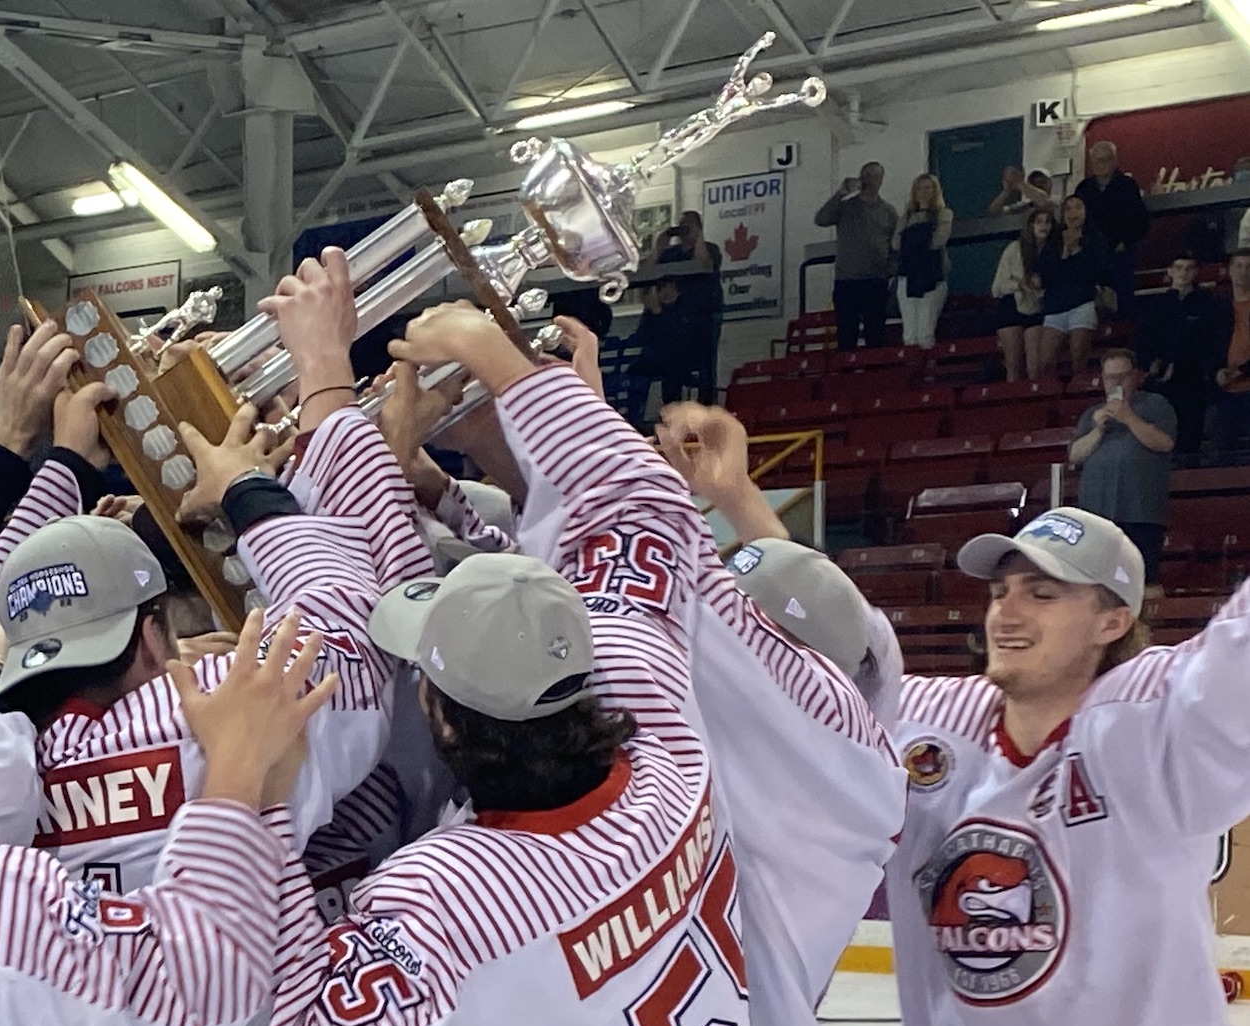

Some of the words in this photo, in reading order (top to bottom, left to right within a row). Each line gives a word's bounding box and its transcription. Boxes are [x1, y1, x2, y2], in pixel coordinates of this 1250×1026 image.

[1039, 101, 1060, 123] K
[777, 145, 793, 166] J
[98, 280, 144, 296] FALCONS
[147, 274, 175, 289] NEST
[7, 571, 87, 619] CHAMPIONS
[40, 762, 172, 834] NNEY
[1060, 752, 1108, 828] A
[572, 804, 713, 982] WILLIAMS
